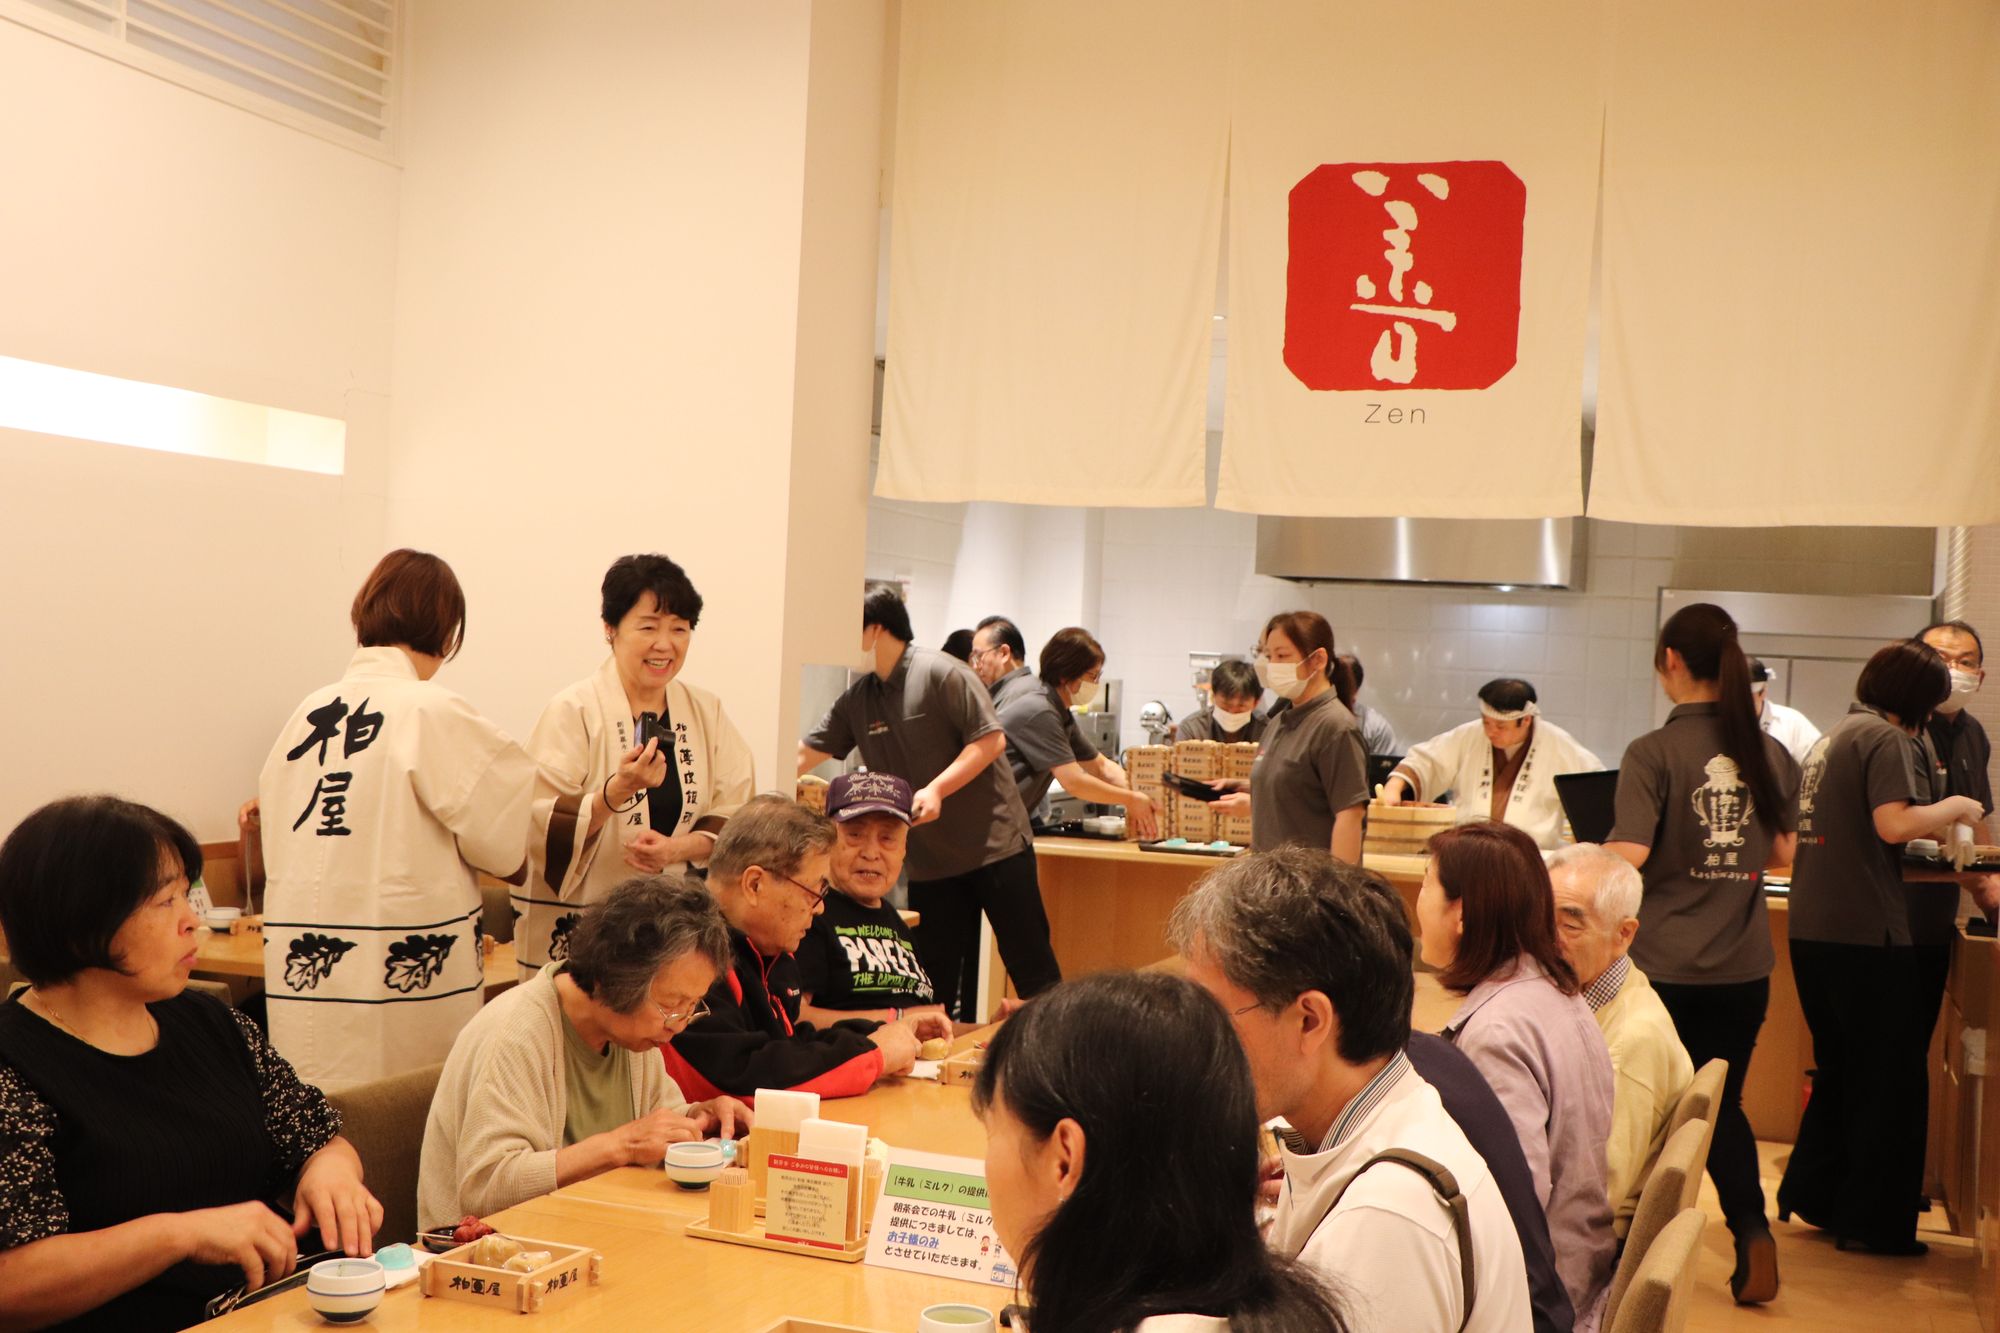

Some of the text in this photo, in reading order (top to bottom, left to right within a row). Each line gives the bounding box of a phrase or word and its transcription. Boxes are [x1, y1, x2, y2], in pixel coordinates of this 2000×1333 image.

[1364, 403, 1427, 424] Zen
[286, 696, 385, 836] 柏屋
[1690, 867, 1750, 881] kashiwaya
[853, 972, 875, 986] THE
[887, 1230, 940, 1249] お子様のみ
